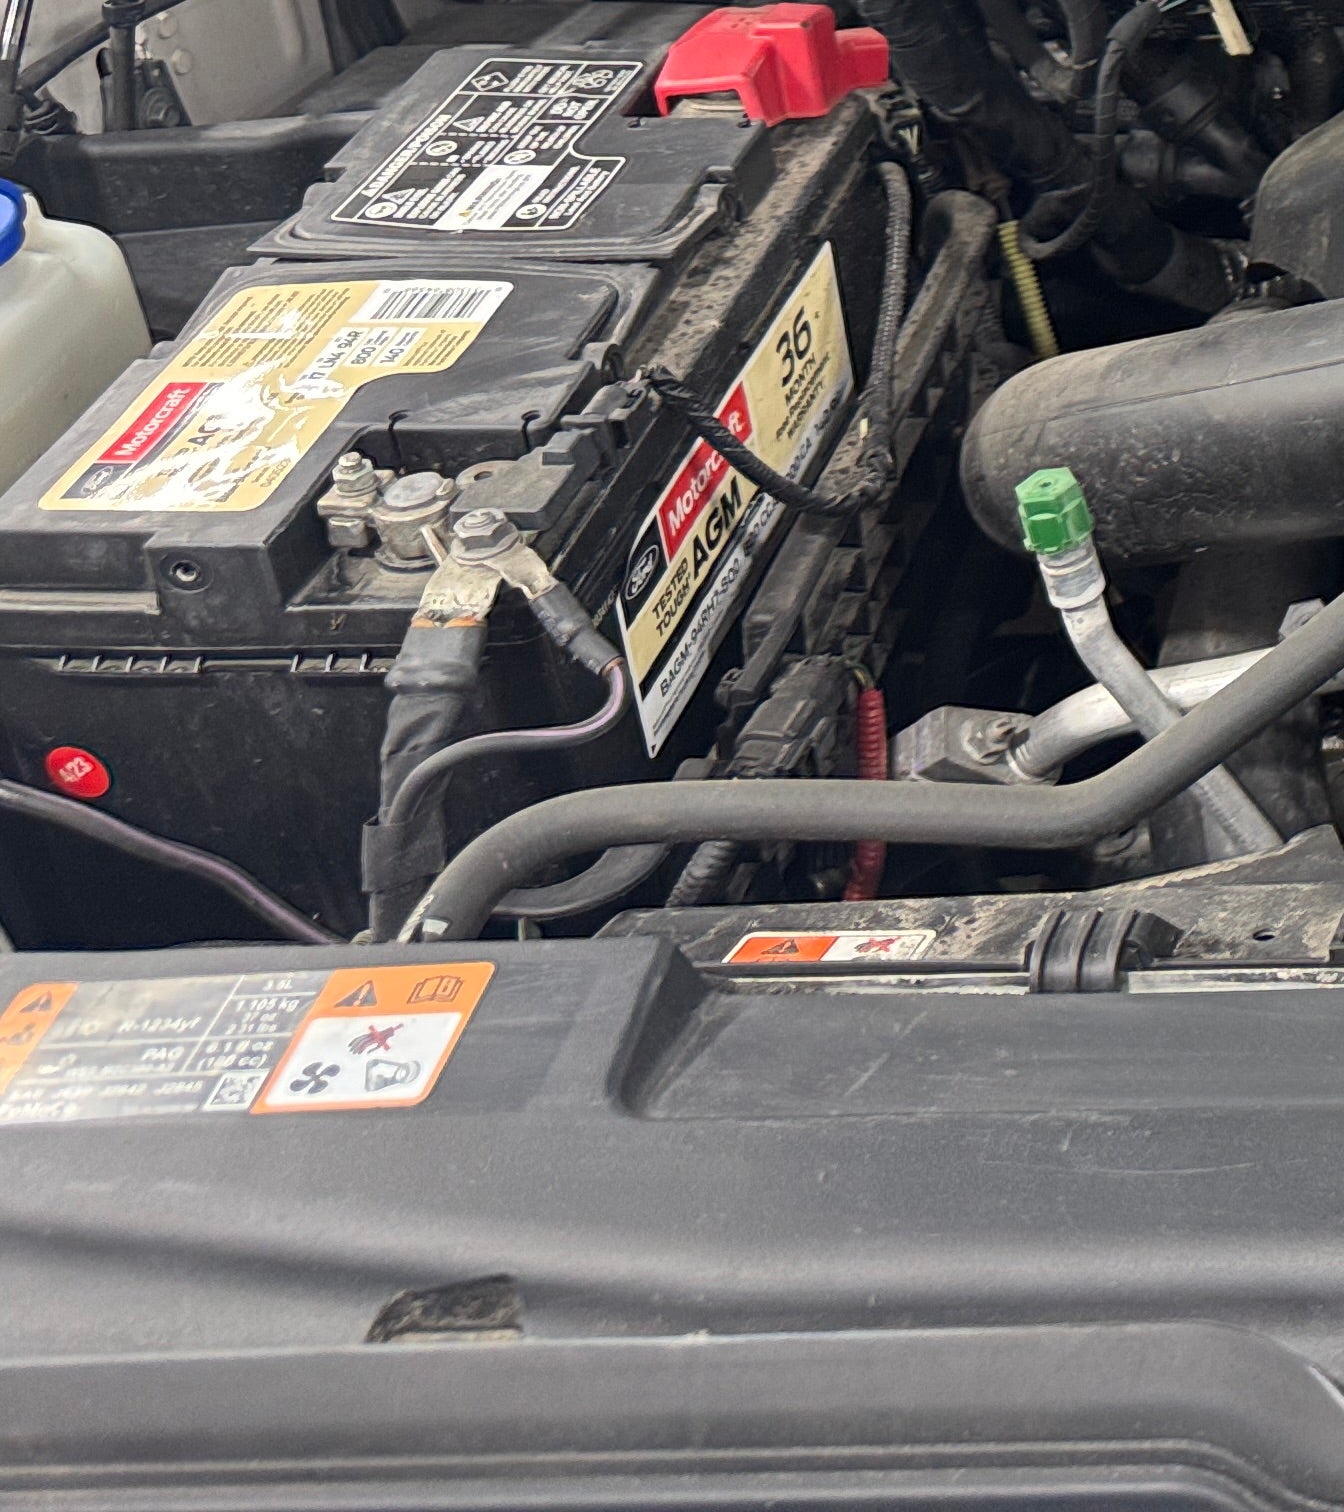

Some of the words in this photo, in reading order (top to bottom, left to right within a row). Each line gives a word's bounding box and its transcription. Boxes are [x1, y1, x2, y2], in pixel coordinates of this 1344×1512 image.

[380, 348, 405, 364] 140
[776, 306, 811, 388] 36
[785, 353, 816, 407] MONTH
[114, 388, 190, 457] Motorcraft
[667, 410, 746, 537] Motorcft
[693, 475, 742, 580] AGM
[652, 556, 689, 620] TESTED
